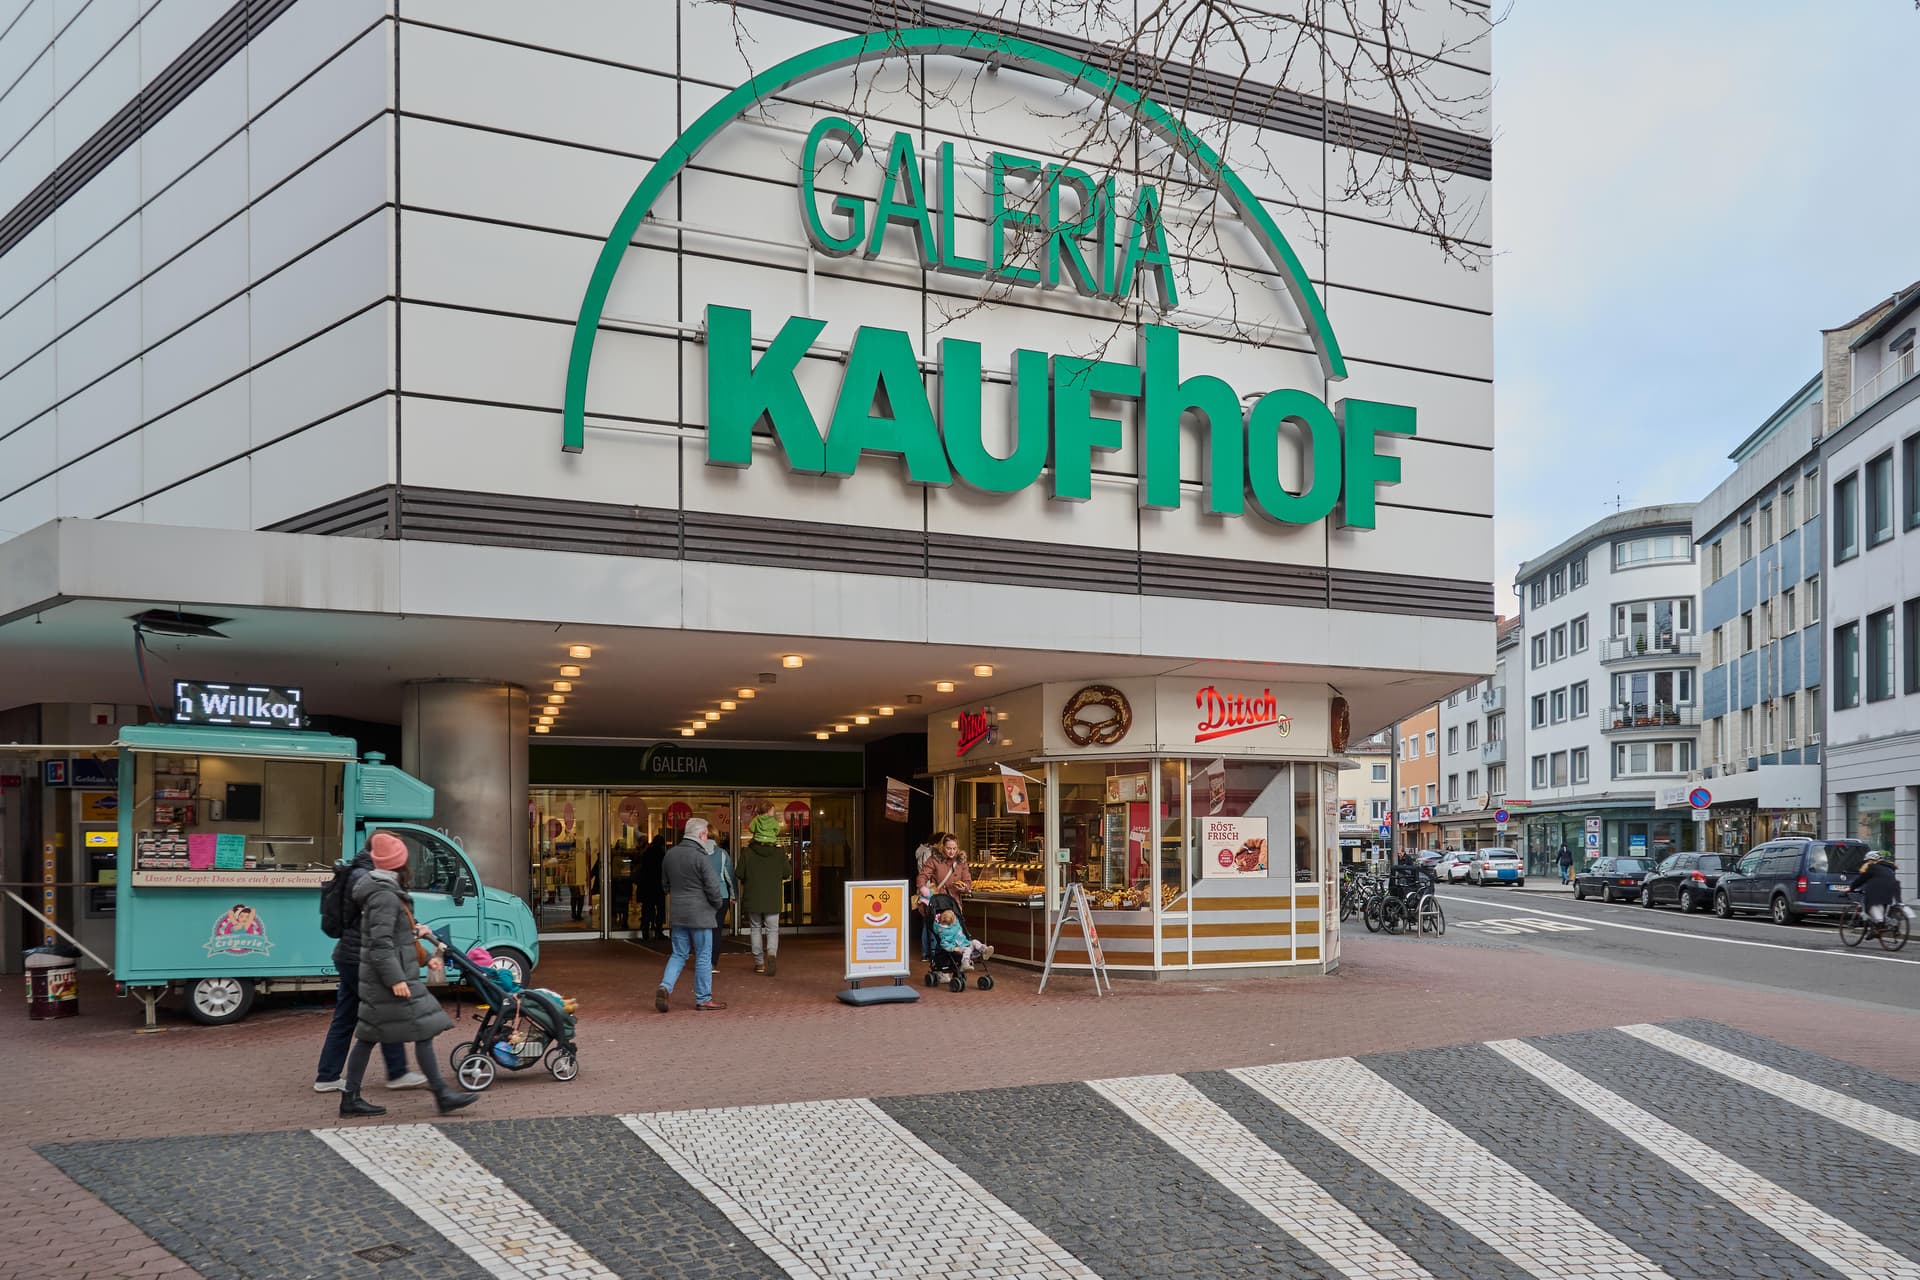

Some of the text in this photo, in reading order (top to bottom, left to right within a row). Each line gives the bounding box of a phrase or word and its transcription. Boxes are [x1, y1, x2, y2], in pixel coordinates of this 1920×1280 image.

[800, 117, 1179, 311] GALERIA
[1196, 686, 1277, 732] Ditsch
[652, 755, 708, 774] GALERIA
[1210, 821, 1236, 831] RÖST-
[1208, 832, 1239, 841] FRISCH
[145, 874, 172, 882] Unser
[212, 874, 234, 882] Dass
